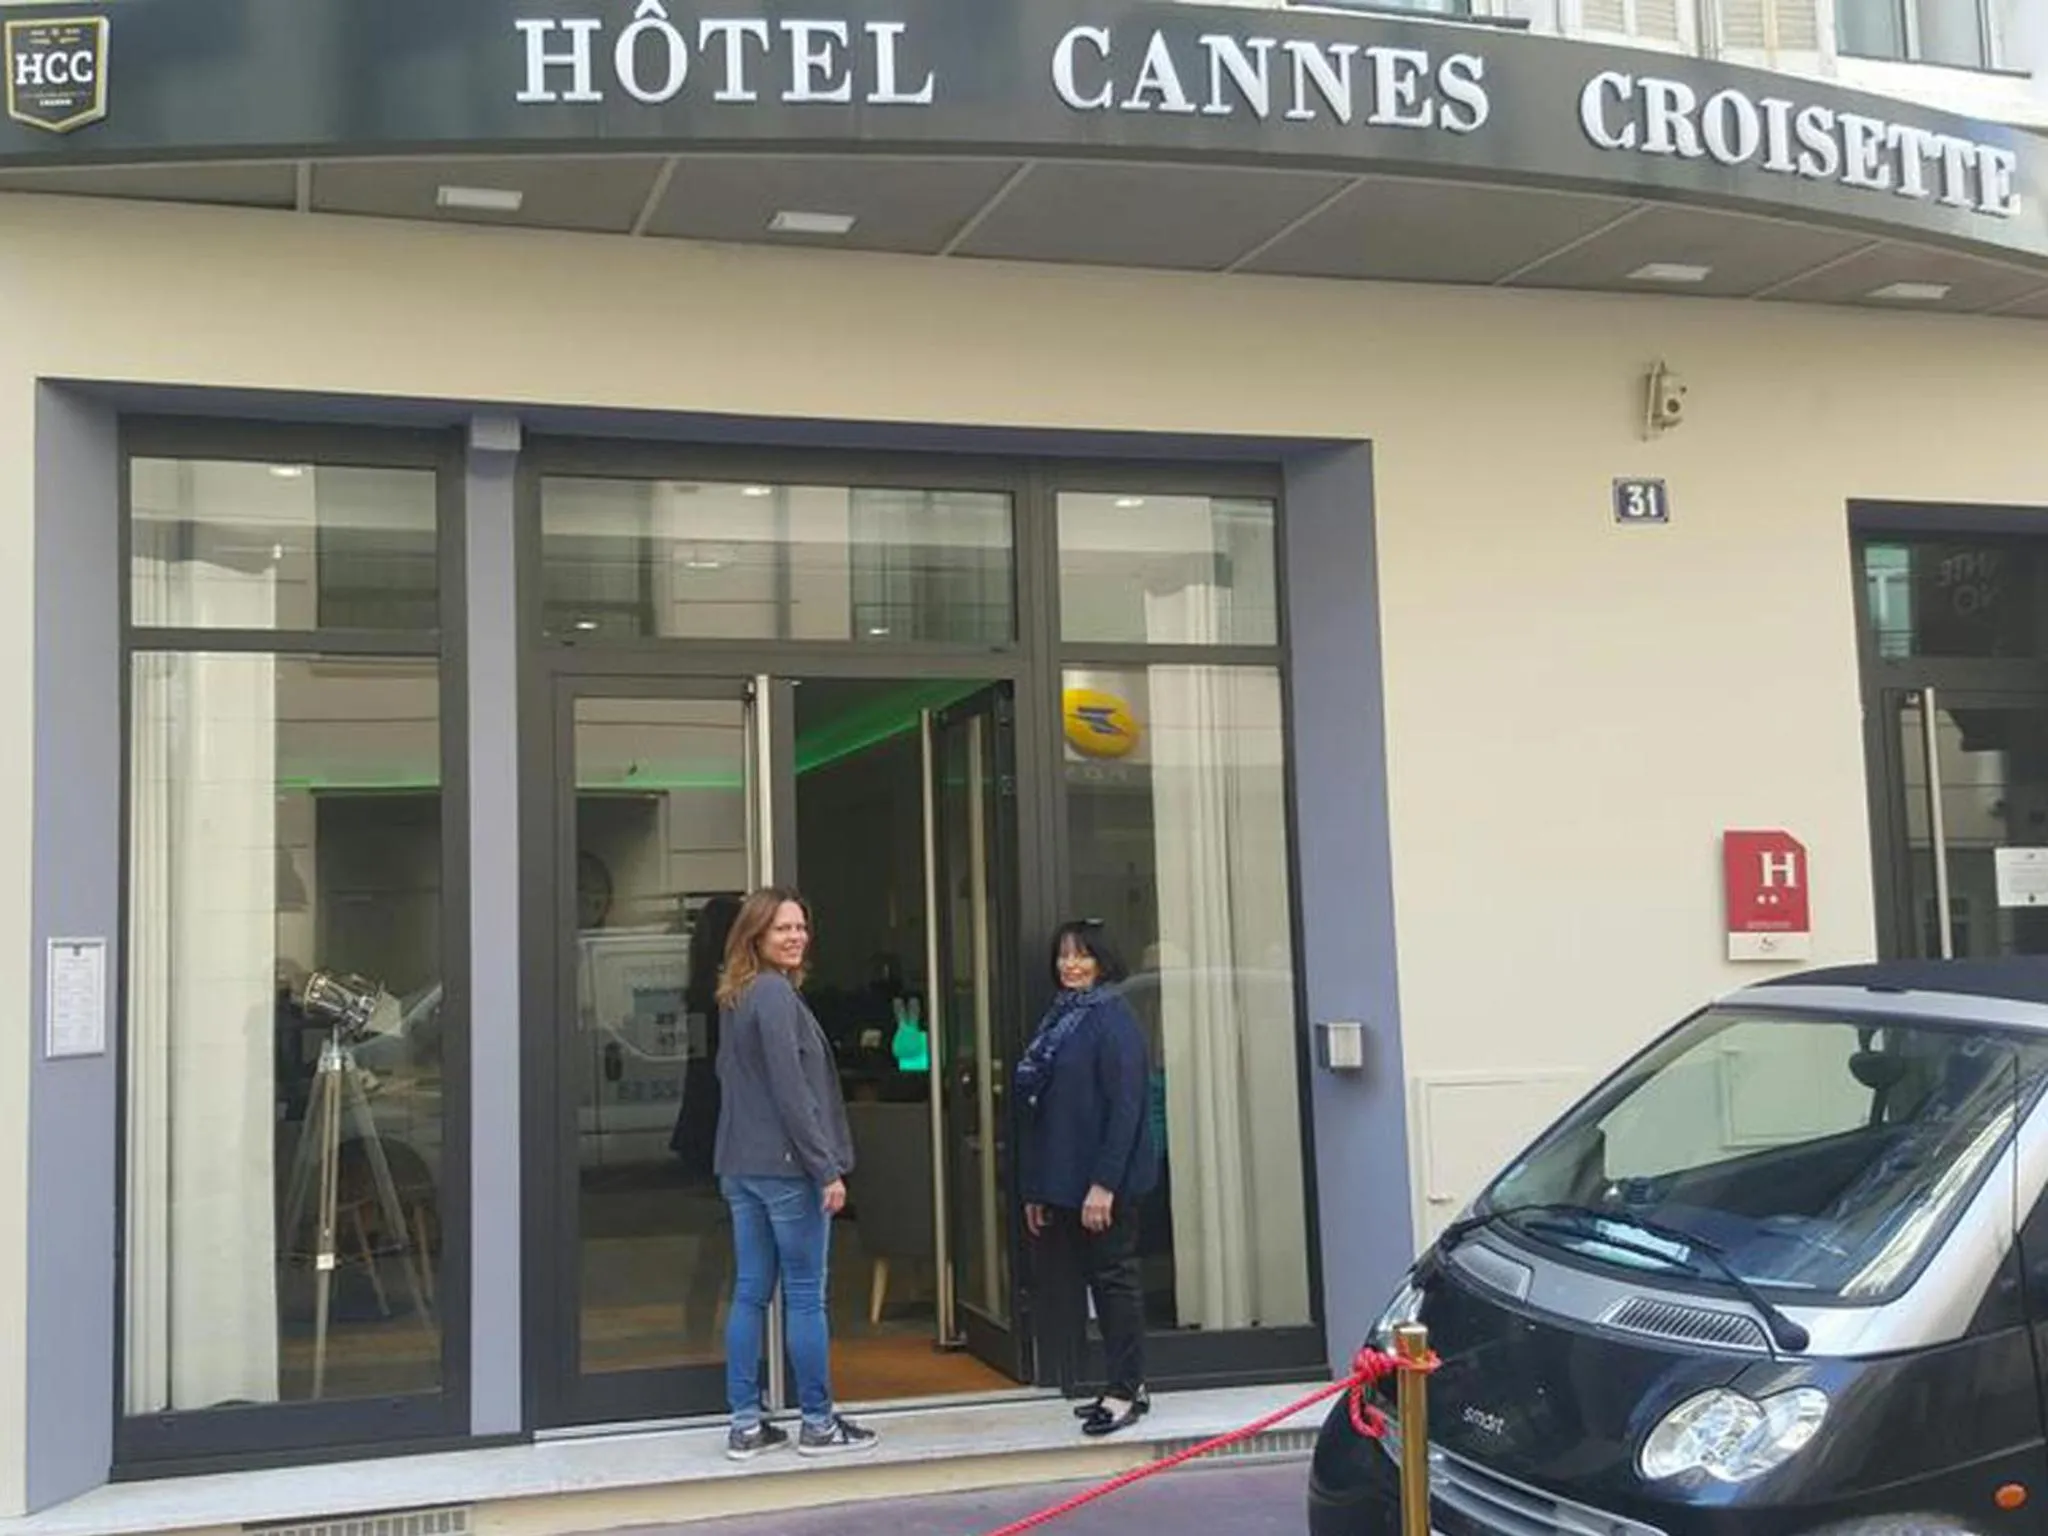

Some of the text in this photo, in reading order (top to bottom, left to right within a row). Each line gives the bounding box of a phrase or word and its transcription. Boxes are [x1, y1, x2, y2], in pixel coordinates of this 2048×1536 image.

[16, 50, 93, 84] HCC
[514, 0, 2022, 216] HÔTEL CANNES CROISETTE
[1627, 485, 1658, 516] 31
[1760, 851, 1798, 888] H
